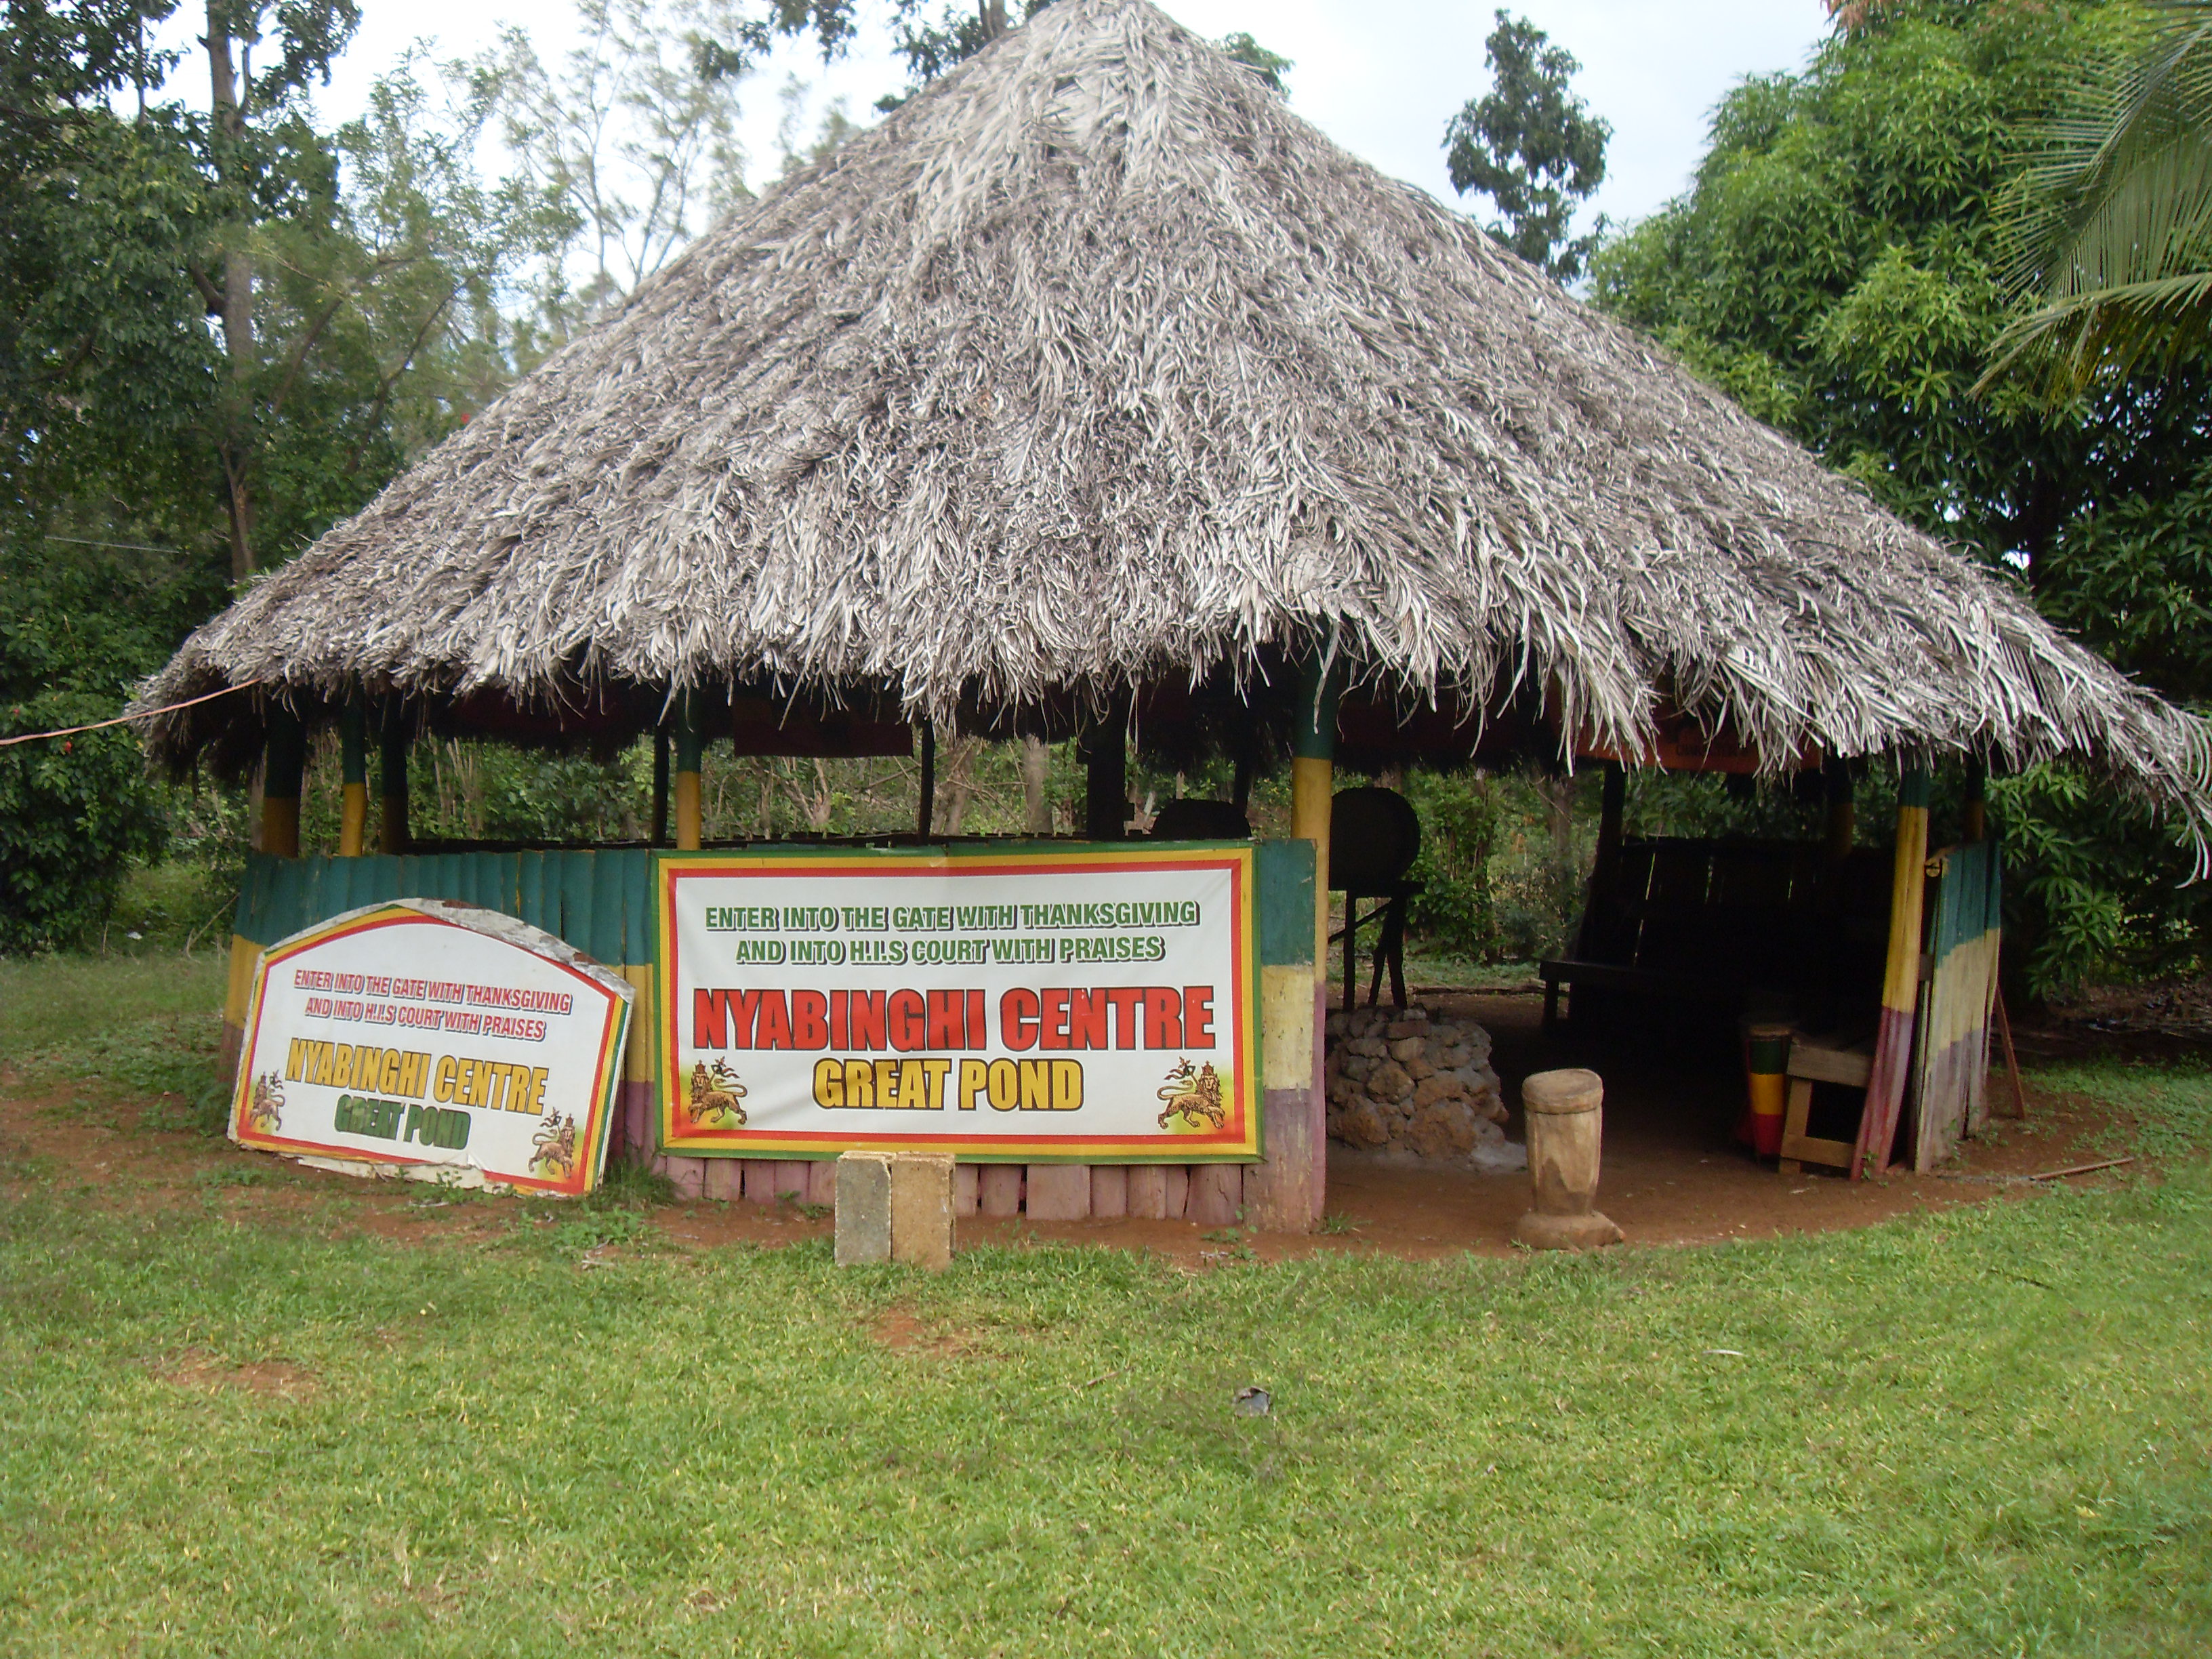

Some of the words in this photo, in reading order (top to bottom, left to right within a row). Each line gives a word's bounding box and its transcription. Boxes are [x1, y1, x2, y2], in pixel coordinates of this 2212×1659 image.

[705, 907, 779, 931] ENTER
[783, 907, 839, 931] INTO
[841, 907, 888, 931] THE
[892, 906, 954, 931] GATE
[956, 904, 1017, 929] WITH
[1020, 901, 1200, 929] THANKSGIVING
[735, 940, 785, 964] AND
[790, 940, 846, 965] INTO
[849, 940, 909, 965] H.I.S
[912, 939, 990, 965] COURT
[992, 938, 1055, 964] WITH
[1059, 936, 1166, 963] PRAISES
[294, 970, 333, 991] ENTER
[333, 972, 365, 994] INTO
[366, 976, 392, 997] THE
[392, 978, 428, 1000] GATE
[428, 981, 465, 1004] WITH
[466, 985, 573, 1015] THANKSGIVING
[305, 998, 333, 1018] AND
[333, 1000, 364, 1021] INTO
[364, 1003, 396, 1025] H.I.S
[398, 1006, 444, 1030] COURT
[445, 1010, 482, 1034] WITH
[483, 1015, 547, 1042] PRAISES
[693, 987, 987, 1052] NYABINGHI
[1000, 985, 1217, 1051] CENTRE
[285, 1038, 432, 1099] NYABINGHI
[434, 1054, 549, 1115] CENTRE
[813, 1057, 952, 1111] GREAT
[958, 1058, 1084, 1113] POND
[335, 1094, 405, 1141] GREAT
[403, 1104, 471, 1150] POND
